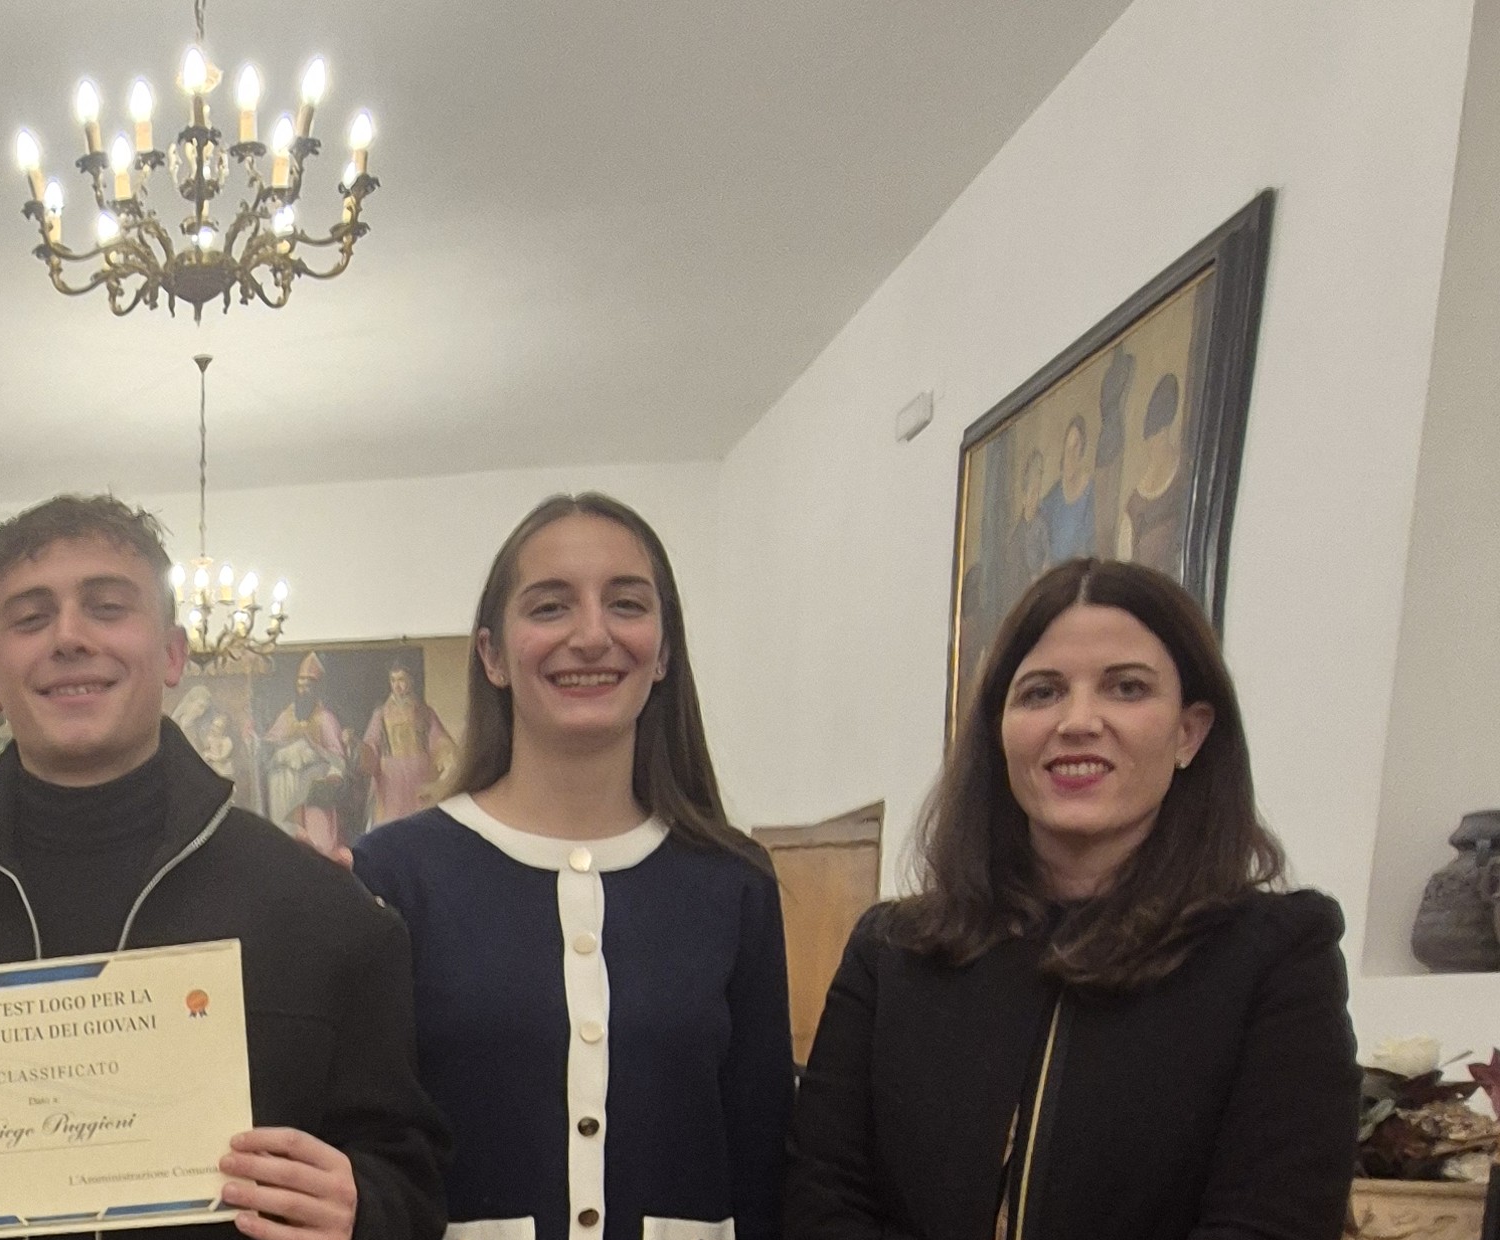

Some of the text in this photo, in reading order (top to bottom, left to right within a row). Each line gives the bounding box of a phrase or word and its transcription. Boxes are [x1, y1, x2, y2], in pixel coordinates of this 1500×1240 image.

[39, 995, 86, 1014] LOGO
[91, 992, 125, 1008] PER
[130, 988, 153, 1004] LA
[49, 1022, 79, 1039] DEI
[83, 1014, 157, 1036] GIOVANI
[41, 1111, 137, 1143] Puggioni
